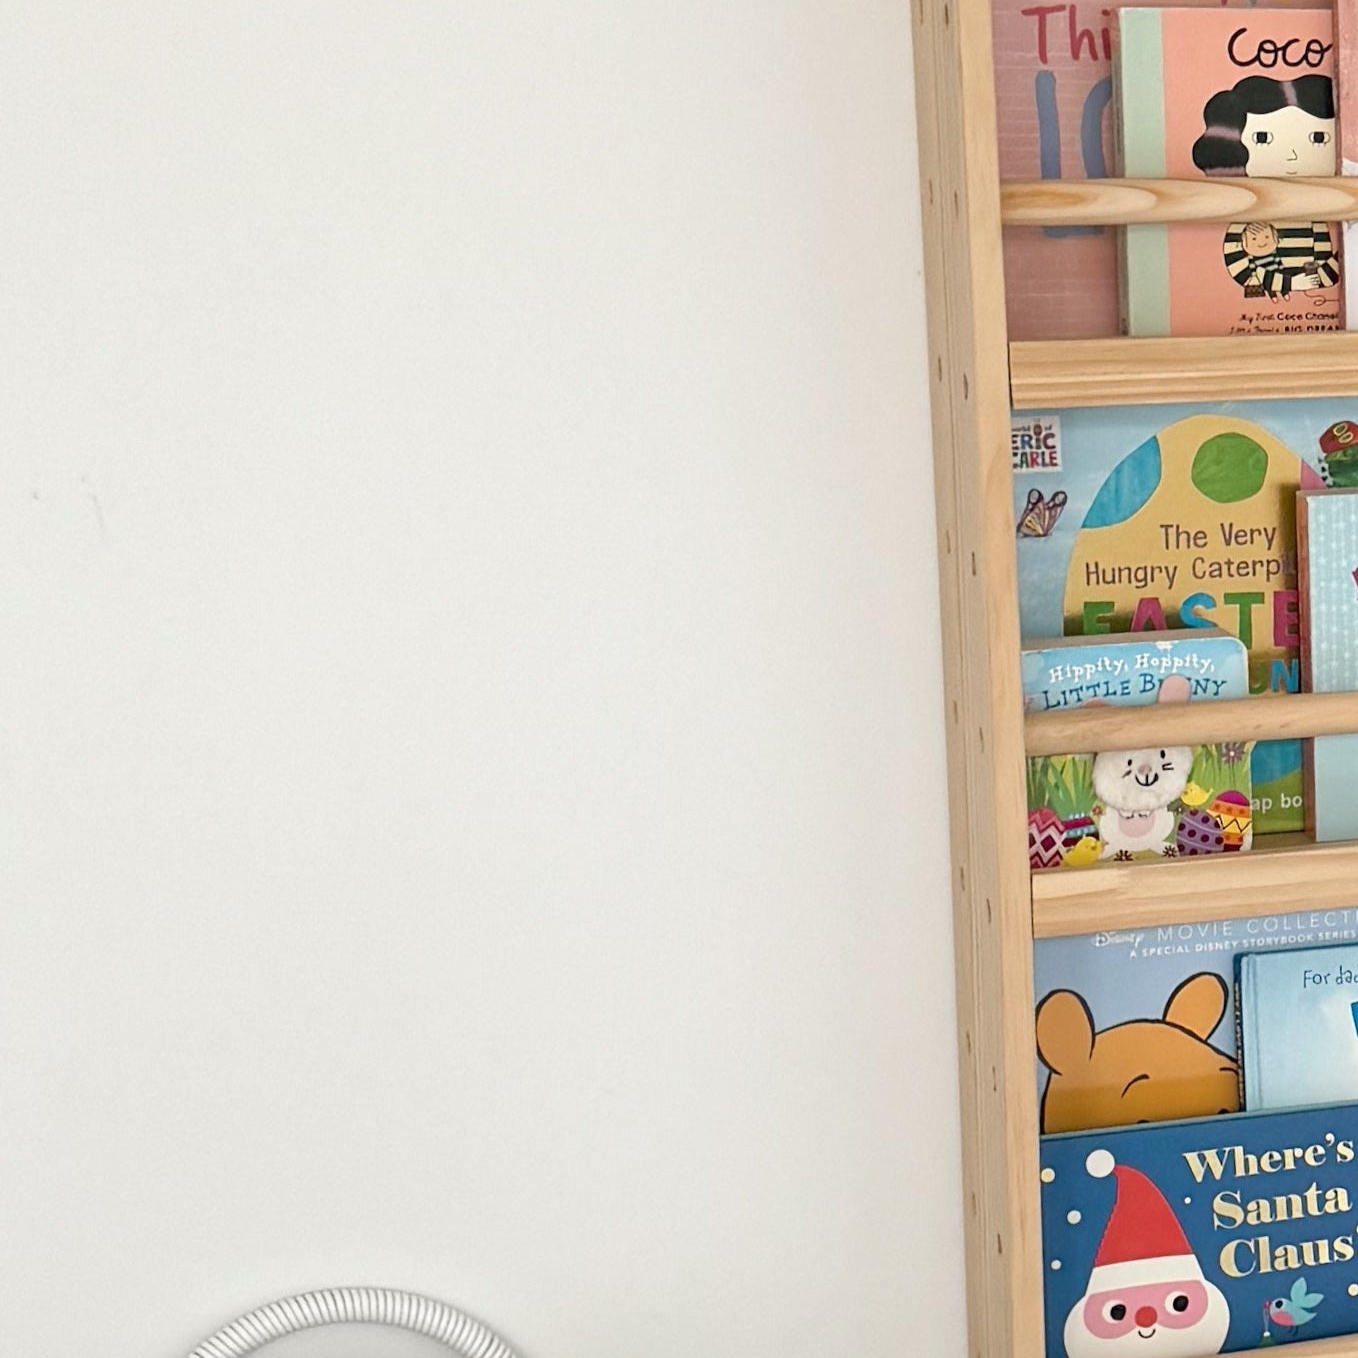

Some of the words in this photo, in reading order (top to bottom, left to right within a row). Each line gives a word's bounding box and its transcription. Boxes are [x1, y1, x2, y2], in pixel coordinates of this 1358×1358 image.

[1161, 525, 1207, 550] The
[1219, 523, 1277, 551] Very
[1085, 562, 1177, 589] Hungry
[1043, 679, 1131, 710] LITTLE
[1156, 921, 1234, 942] MOVIE
[1302, 968, 1331, 988] For
[1212, 1182, 1352, 1231] Santa
